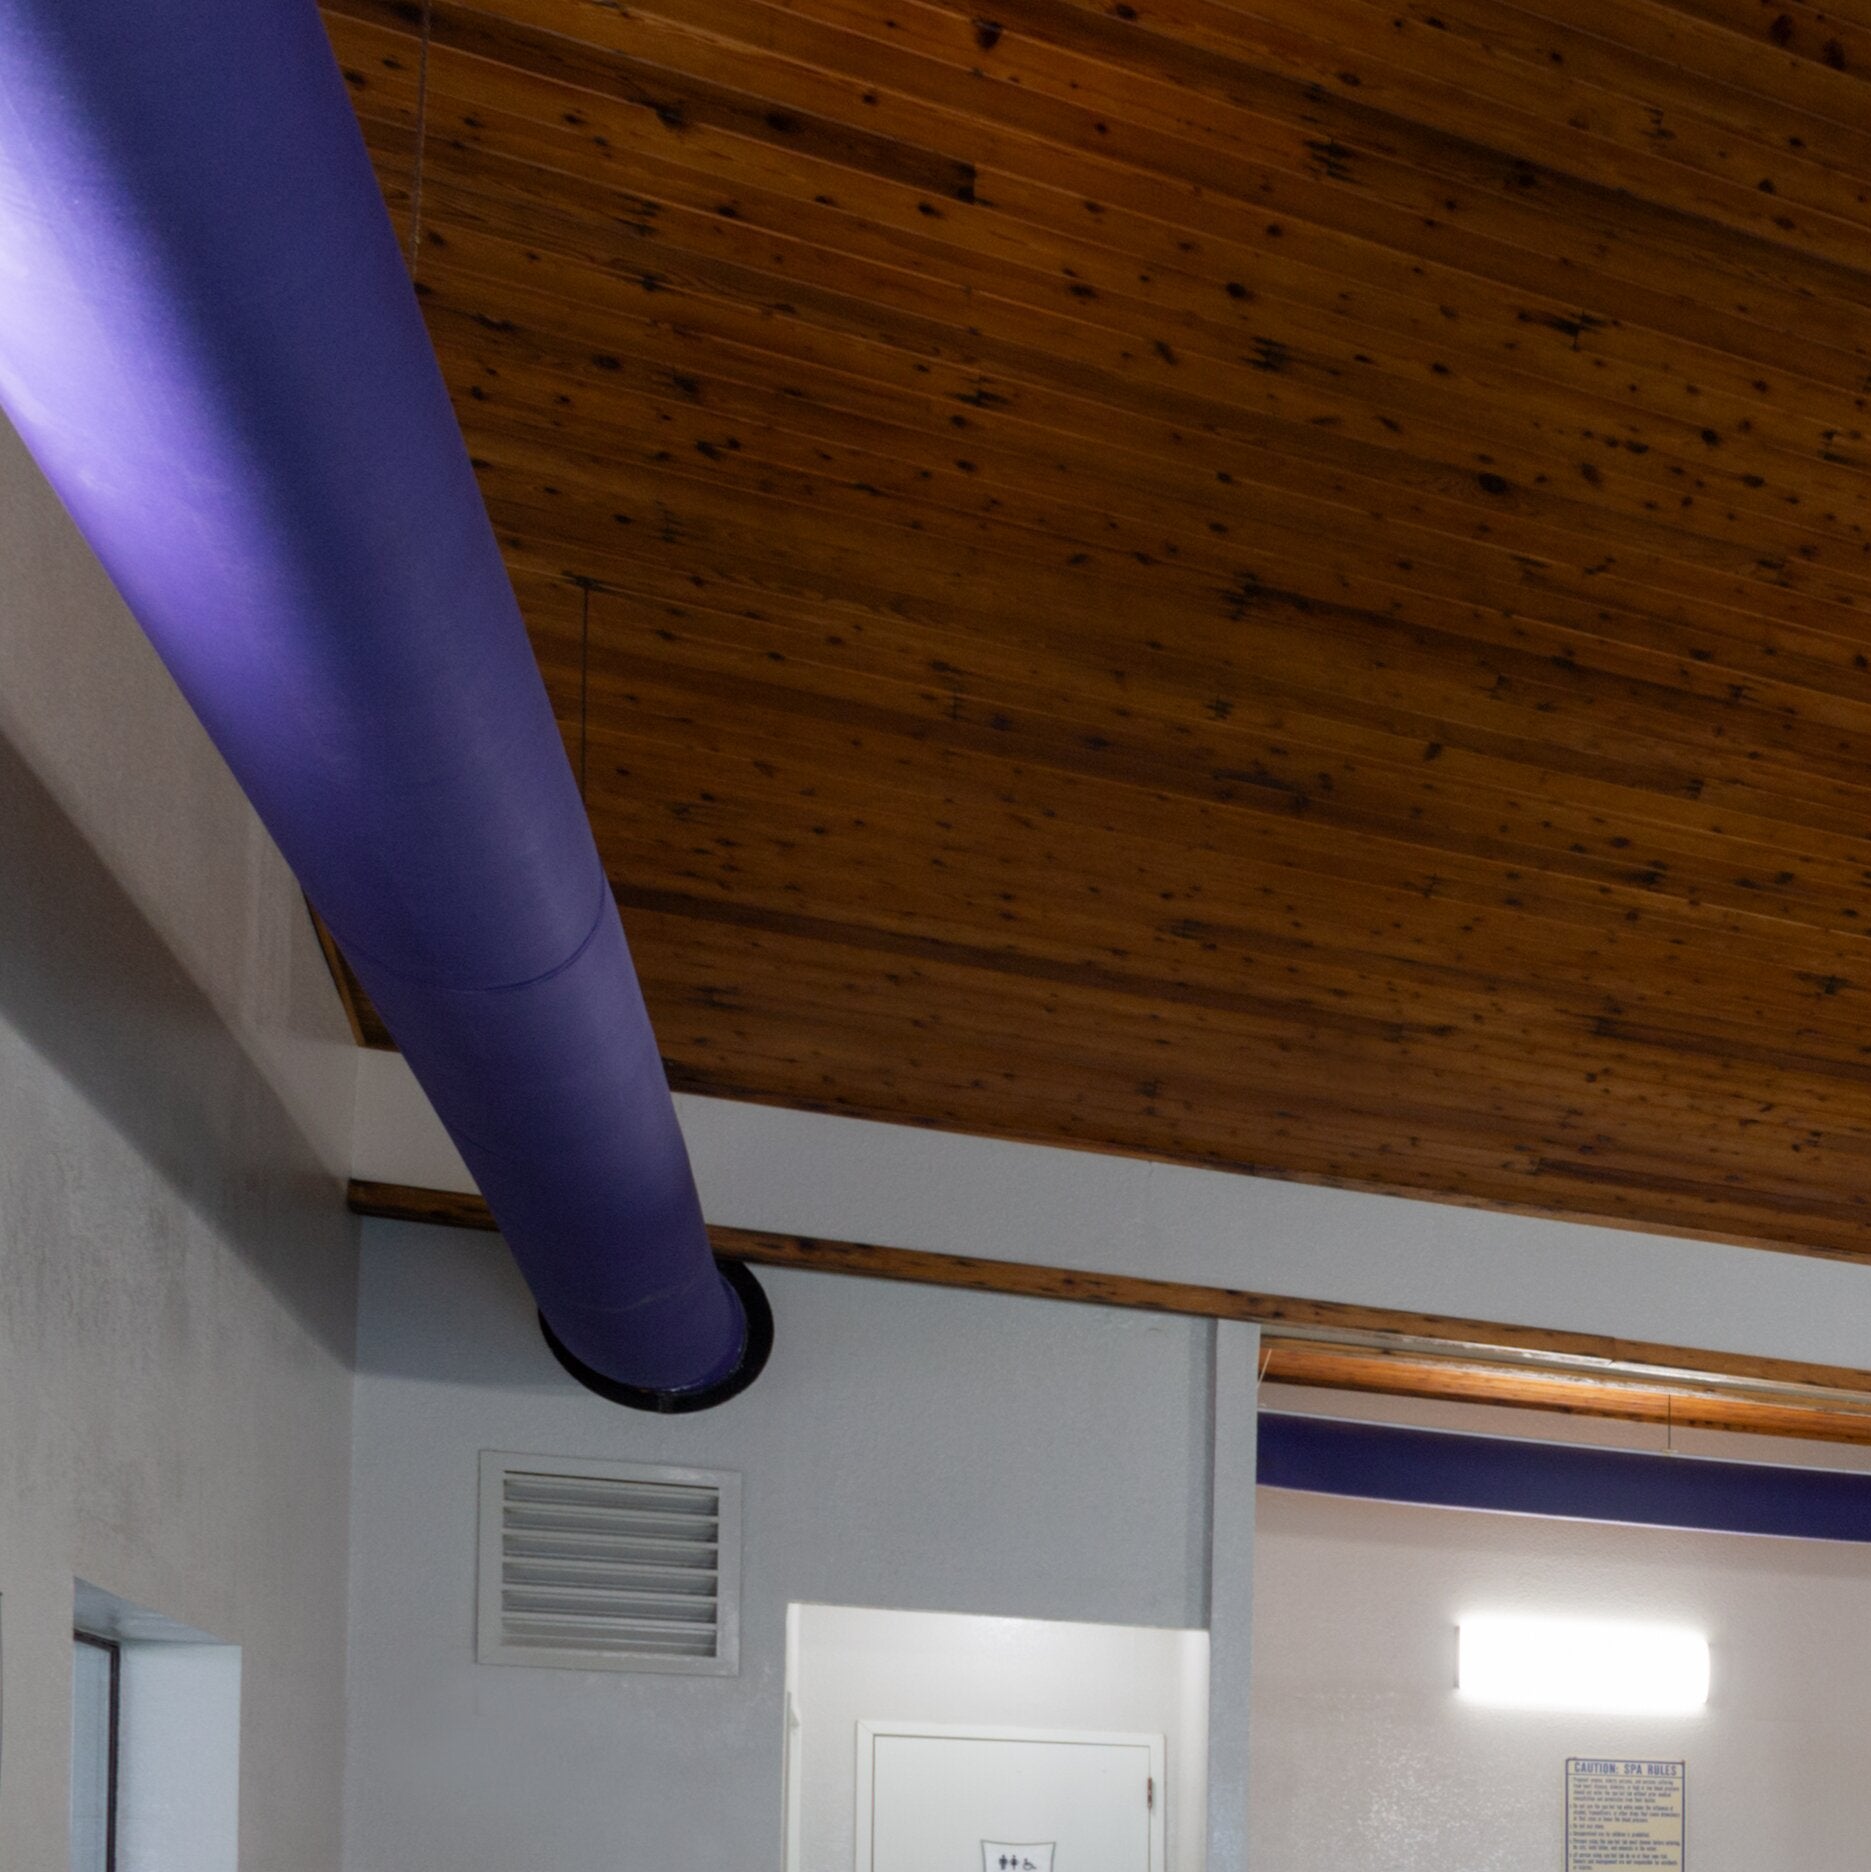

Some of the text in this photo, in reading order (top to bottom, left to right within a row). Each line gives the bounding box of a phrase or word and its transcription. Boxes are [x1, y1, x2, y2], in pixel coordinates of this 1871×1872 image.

[1574, 1762, 1677, 1776] CAUTION: SPA RULES
